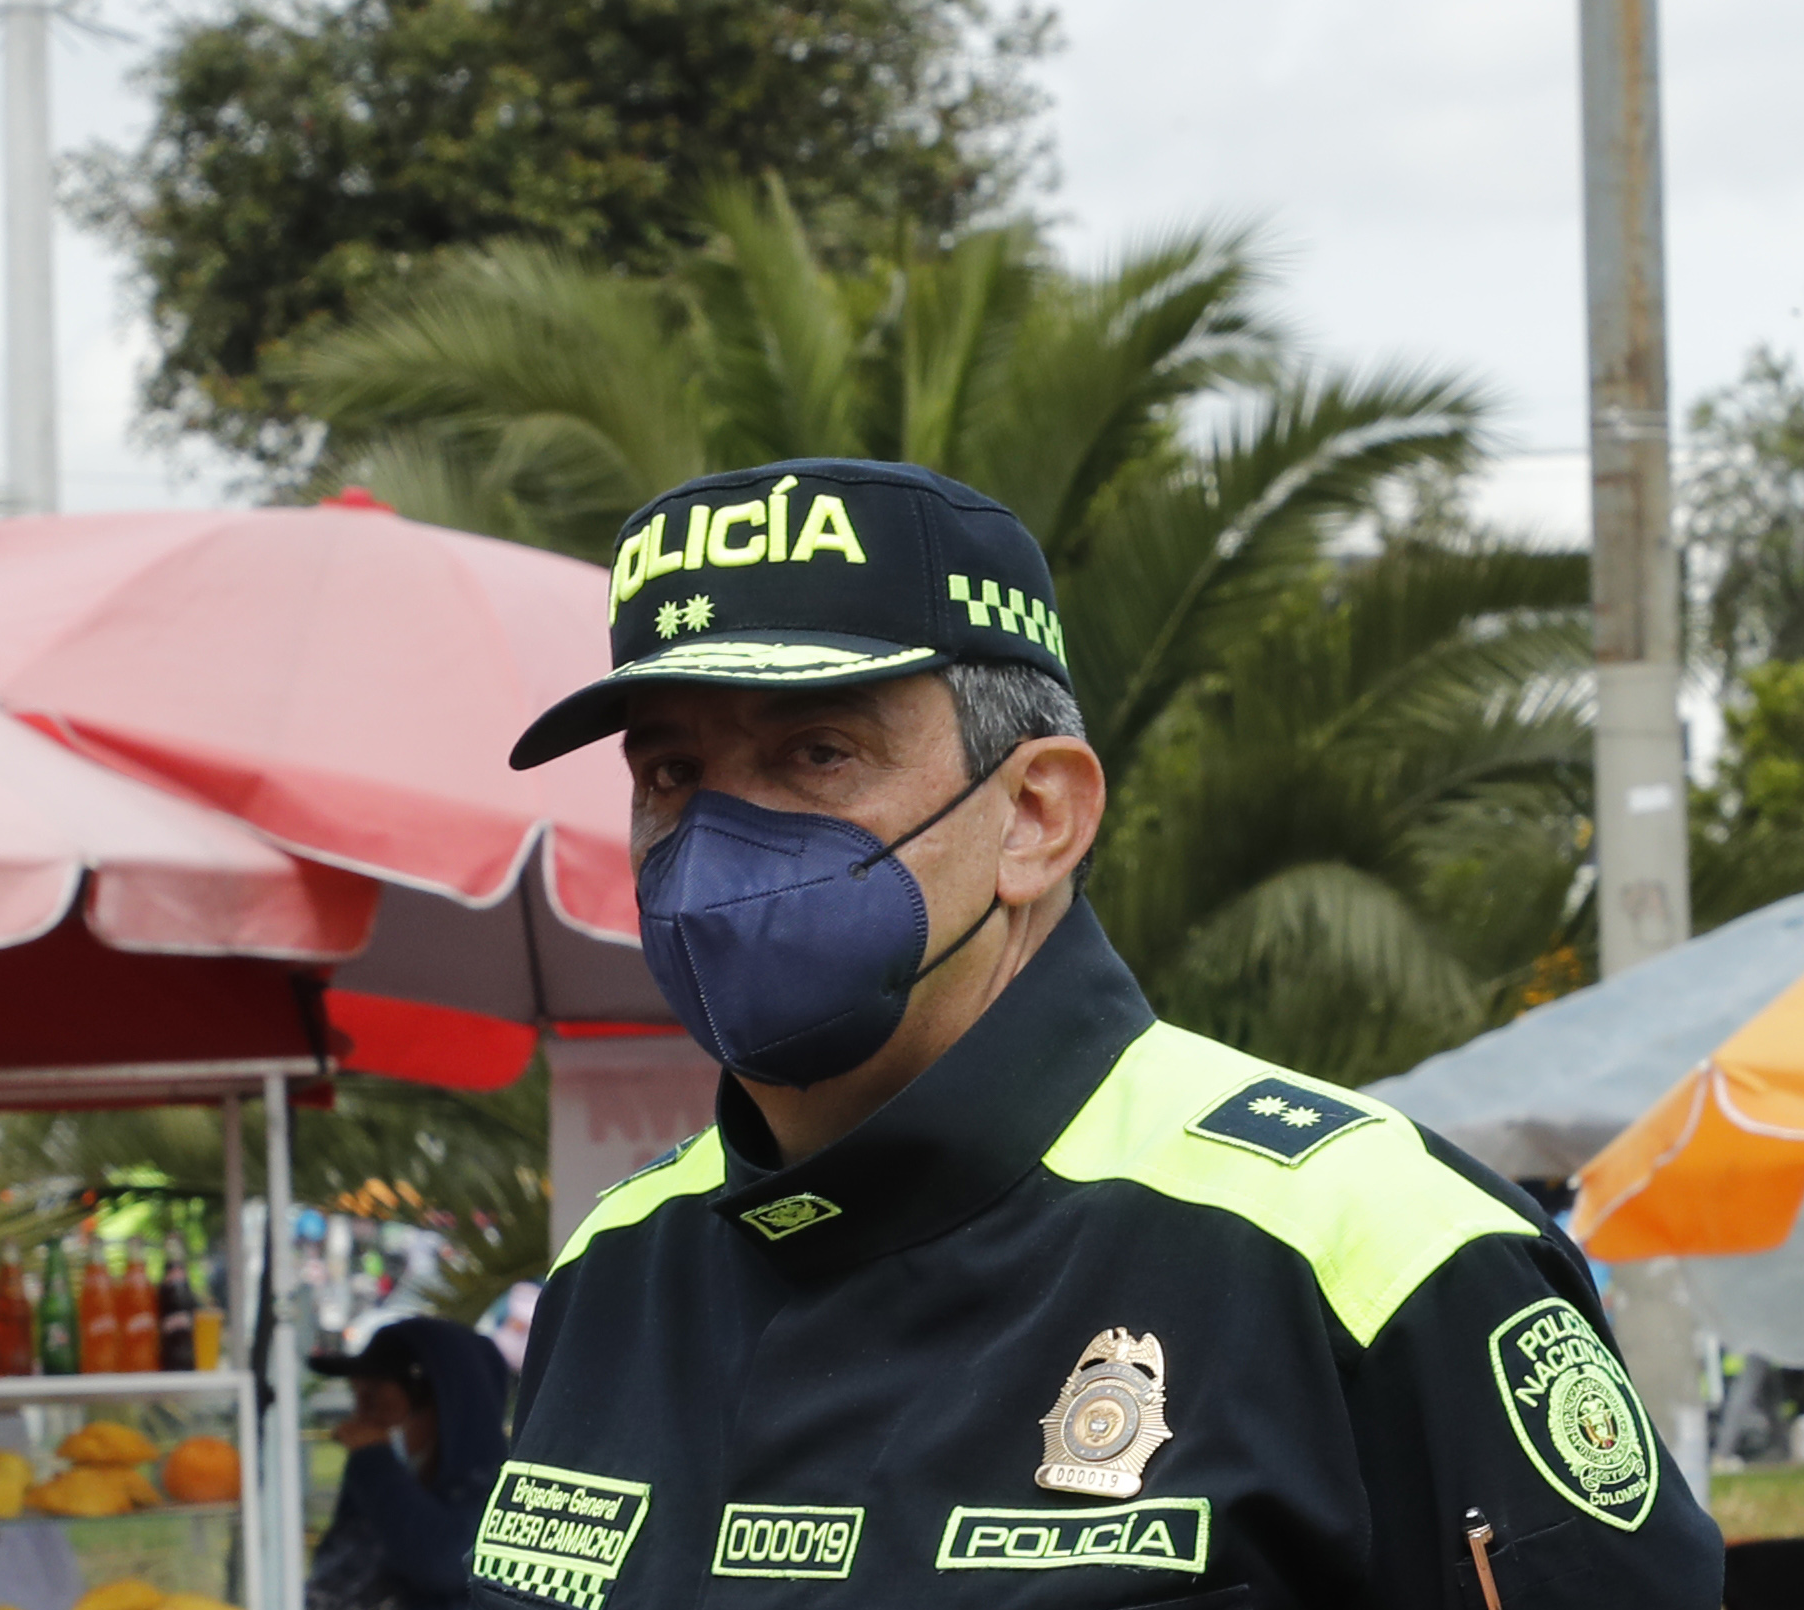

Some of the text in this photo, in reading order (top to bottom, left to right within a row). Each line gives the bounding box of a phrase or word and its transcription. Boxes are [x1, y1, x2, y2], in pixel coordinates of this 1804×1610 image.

[608, 474, 867, 627] OLICÍA
[511, 1476, 624, 1521] Brigadier General
[1056, 1467, 1119, 1488] 000019
[485, 1509, 625, 1562] ELIECER CAMACHO
[727, 1518, 851, 1564] 000019
[966, 1513, 1177, 1558] POLICÍA
